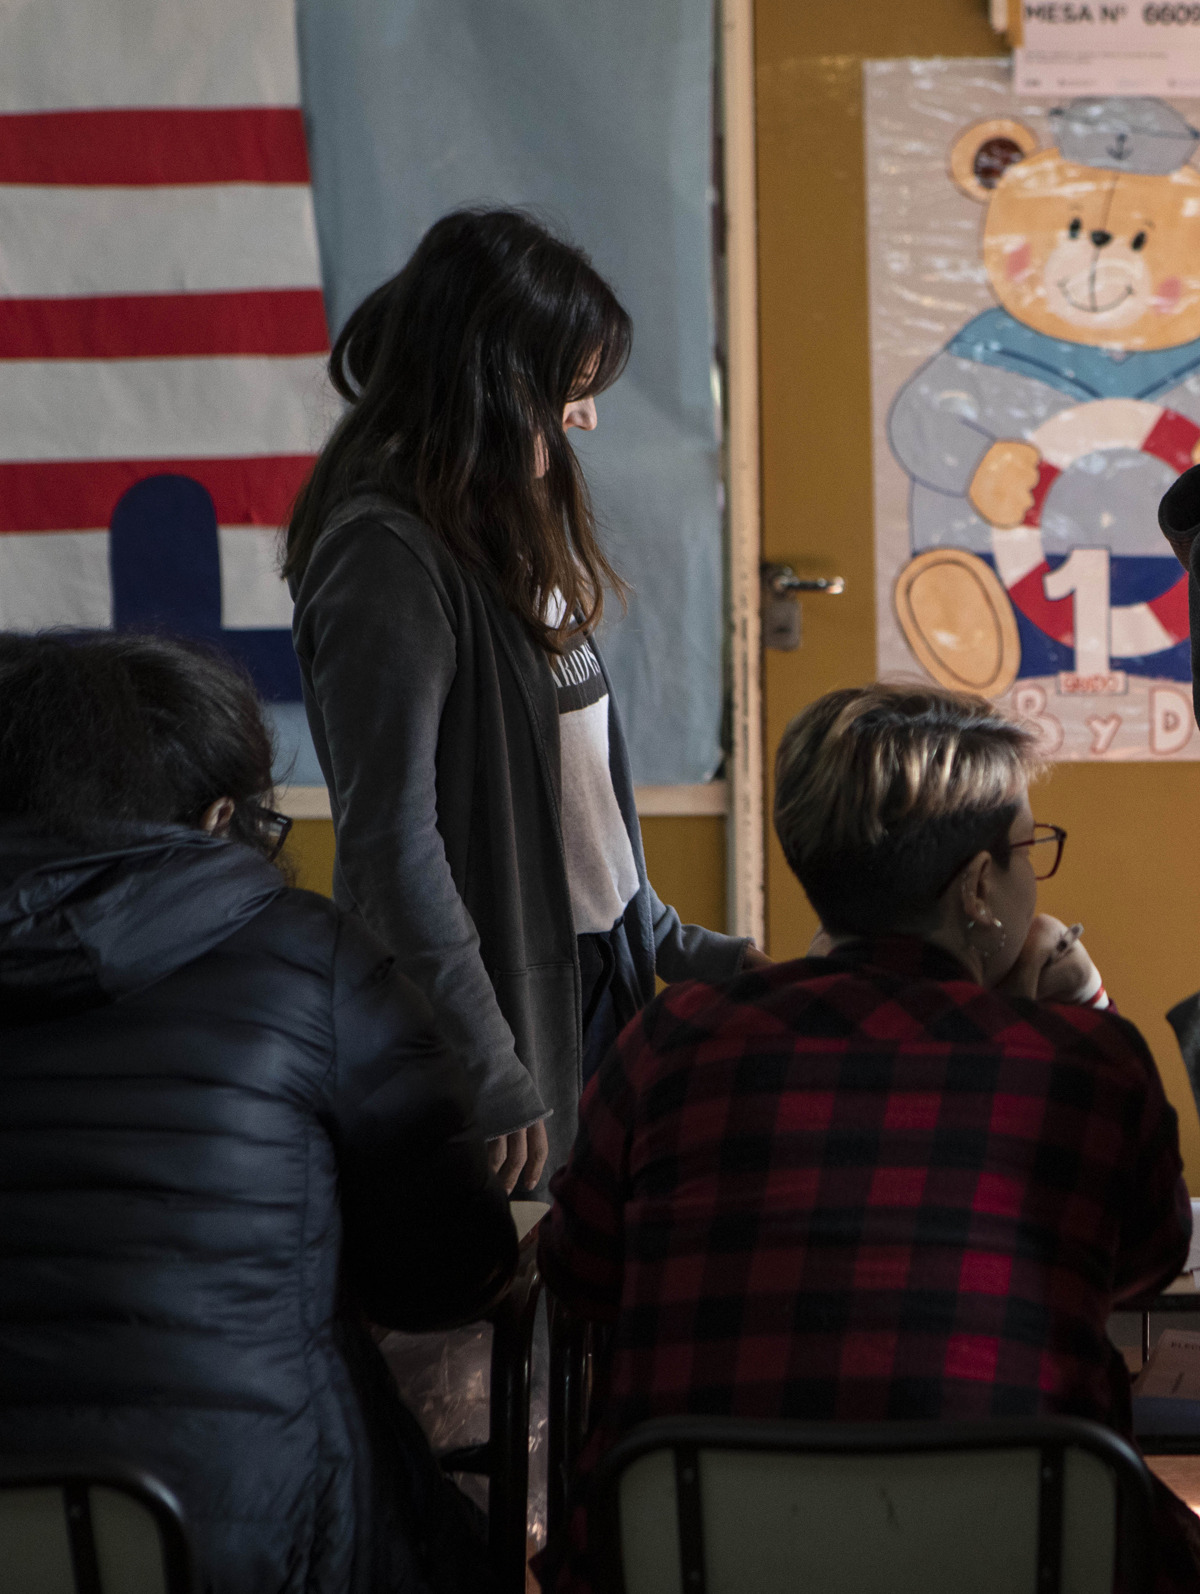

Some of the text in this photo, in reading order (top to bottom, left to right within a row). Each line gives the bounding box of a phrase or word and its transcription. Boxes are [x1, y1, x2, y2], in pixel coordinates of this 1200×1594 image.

[1025, 3, 1094, 24] MESA
[1043, 547, 1118, 686] 1
[1149, 685, 1194, 756] D
